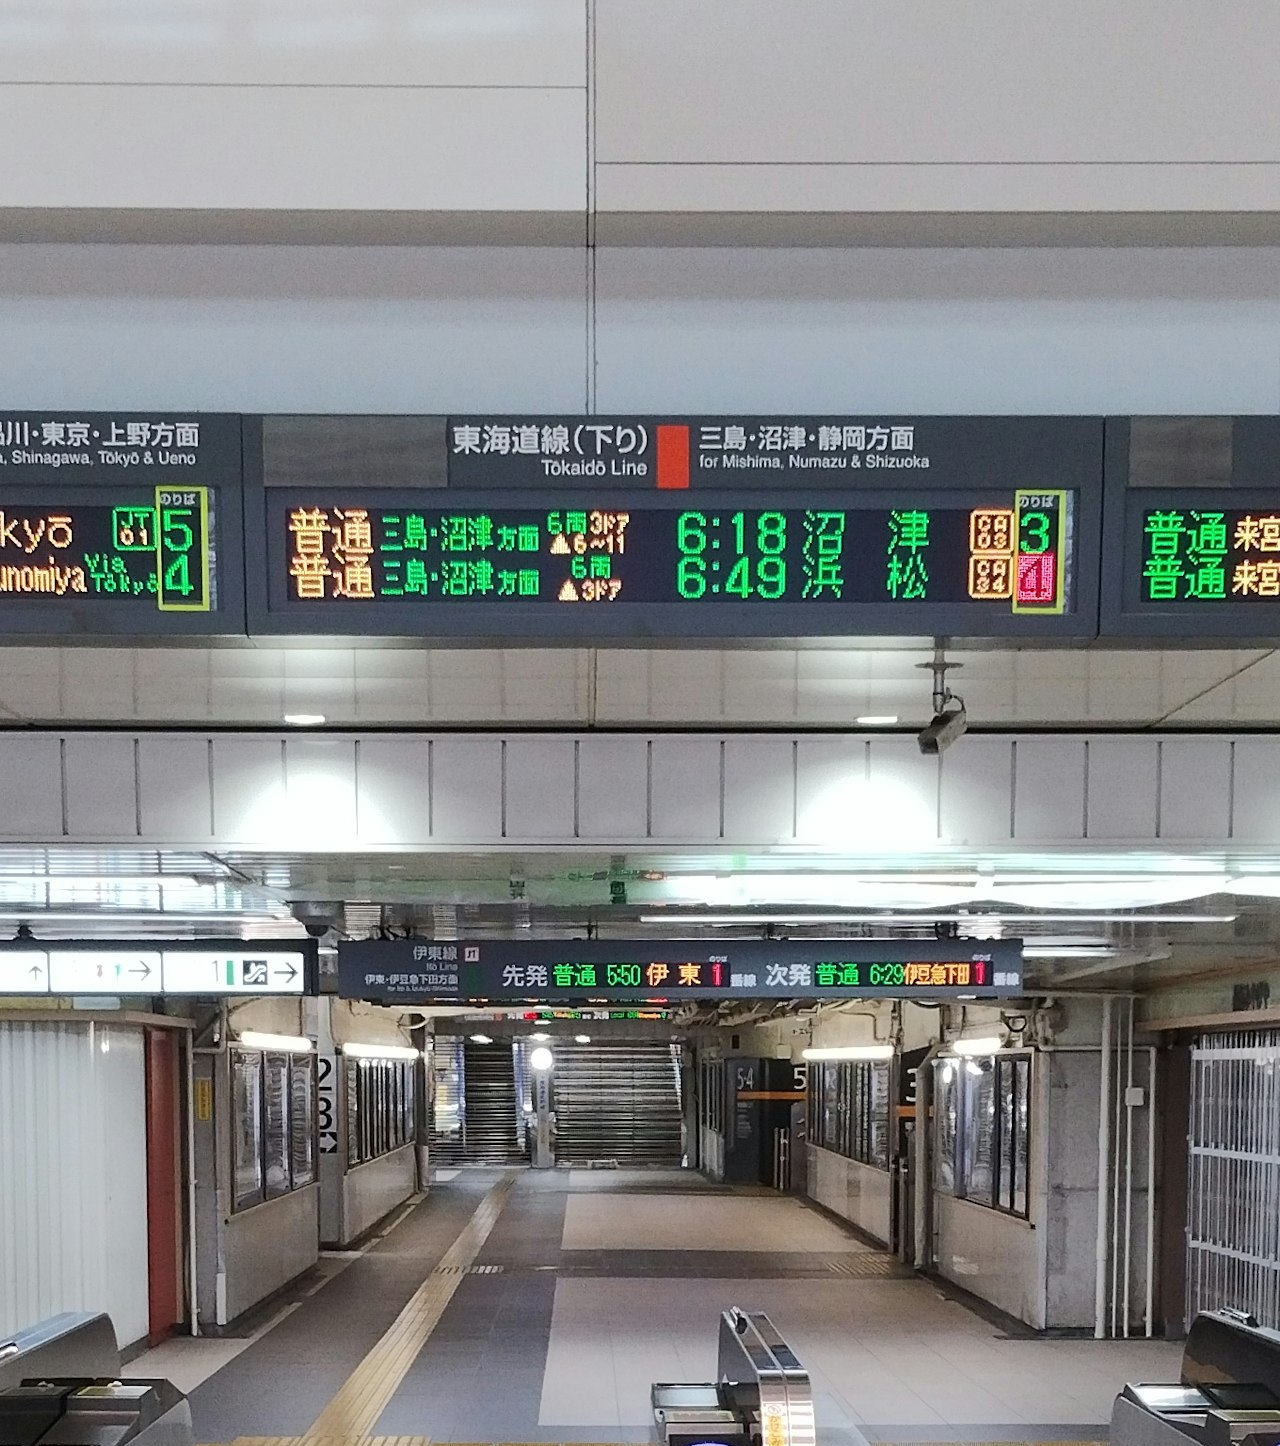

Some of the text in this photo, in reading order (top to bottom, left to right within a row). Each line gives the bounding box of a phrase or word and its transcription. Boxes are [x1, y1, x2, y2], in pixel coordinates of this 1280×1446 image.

[452, 424, 649, 456] 東海道線(下り)
[698, 425, 915, 451] 三島・沼津・静岡方面
[11, 449, 95, 468] Shinagawa,
[143, 450, 154, 465] &
[158, 450, 197, 465] Ueno
[611, 458, 649, 477] Line
[699, 454, 931, 470] for Mishima, Numazu & Shizuoka
[160, 493, 196, 505] のりば
[1018, 494, 1055, 508] のりば
[162, 508, 194, 552] 5
[289, 506, 374, 554] 普通
[676, 510, 788, 556] 6:18
[1020, 511, 1051, 555] 3
[1143, 510, 1229, 555] 普通
[164, 553, 195, 597] 4
[289, 554, 375, 599] 普通
[676, 555, 788, 599] 6:49
[1142, 555, 1228, 600] 普通
[412, 945, 459, 962] 伊東線
[501, 964, 549, 988] 先発
[552, 963, 598, 987] 普通
[606, 964, 642, 987] 5:50
[712, 963, 722, 987] 1
[764, 962, 812, 987] 次発
[815, 962, 860, 987] 普通
[869, 964, 904, 986] 6:29
[903, 962, 970, 986] 伊豆急下田
[975, 961, 985, 985] 1
[793, 1067, 808, 1090] 5
